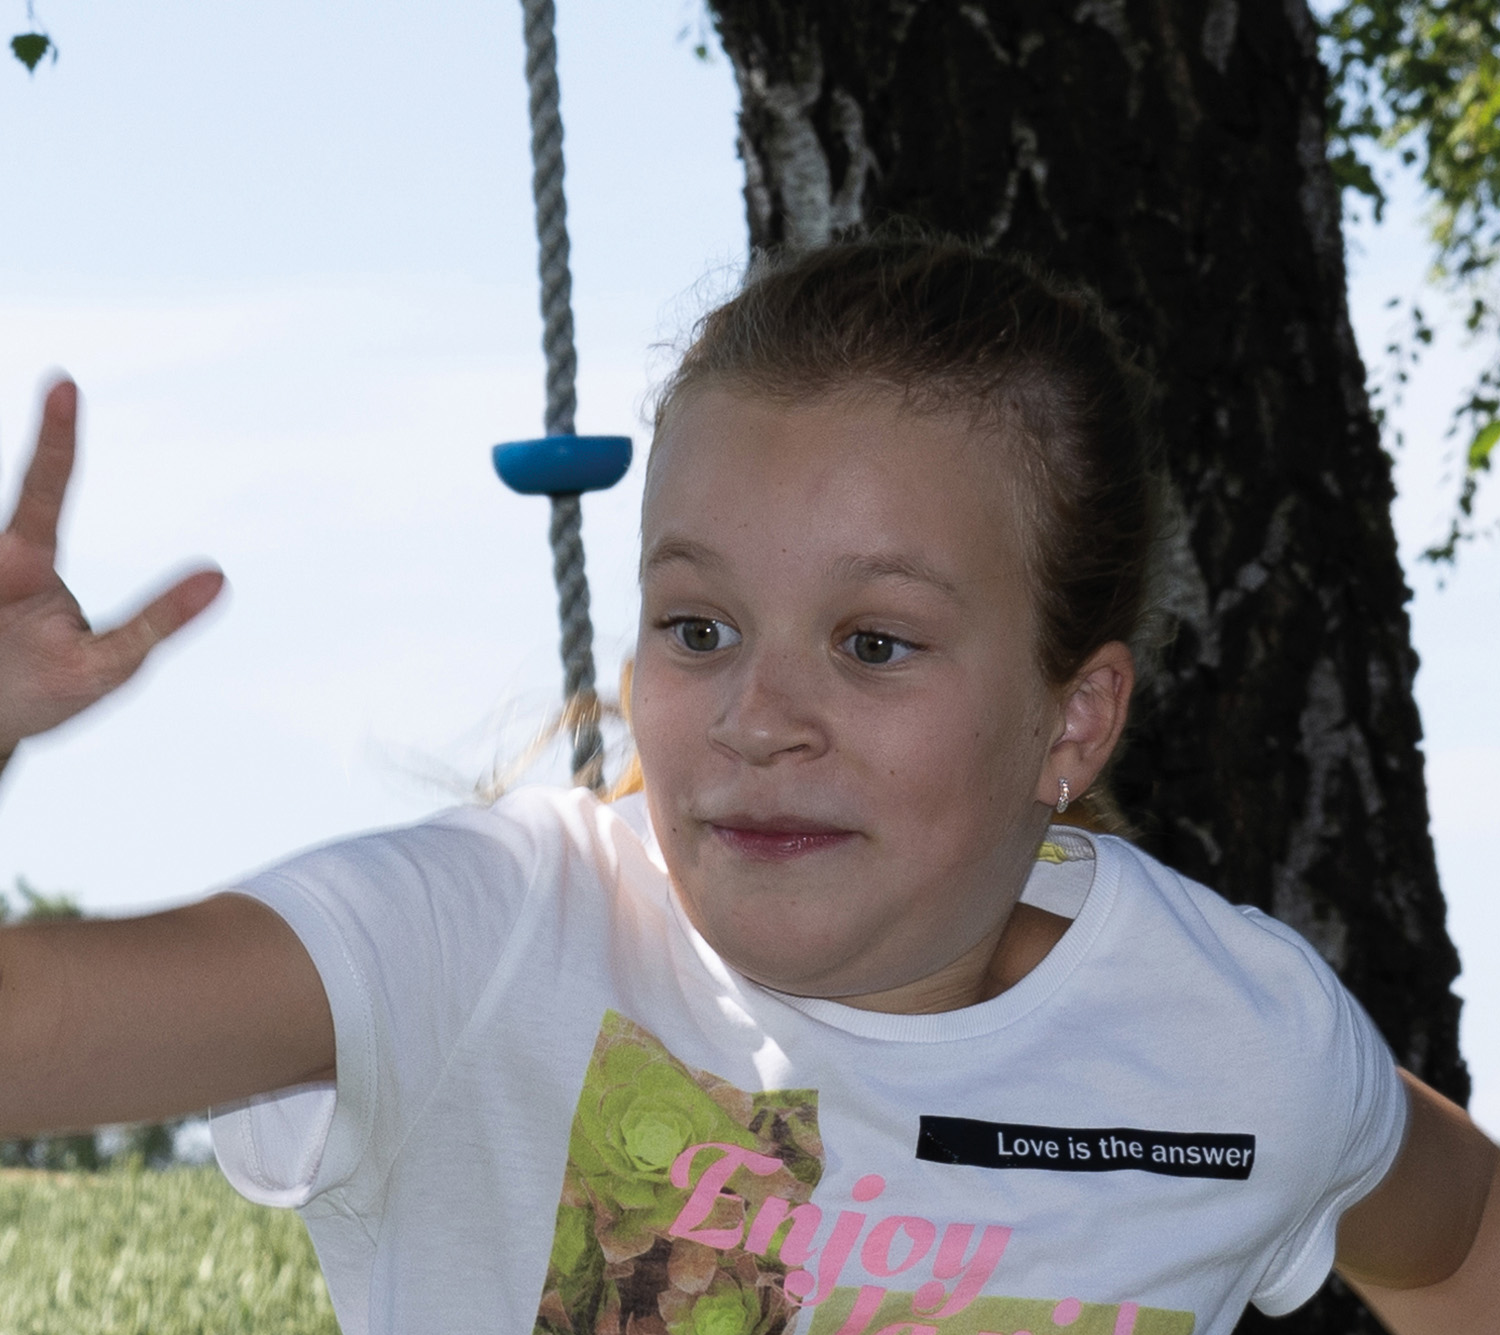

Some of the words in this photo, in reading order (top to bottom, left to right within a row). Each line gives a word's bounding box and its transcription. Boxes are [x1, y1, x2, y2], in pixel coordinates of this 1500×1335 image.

[997, 1131, 1059, 1159] Love
[1068, 1136, 1091, 1160] is
[1098, 1135, 1144, 1159] the
[1151, 1144, 1252, 1168] answer
[668, 1141, 1014, 1318] Enjoy
